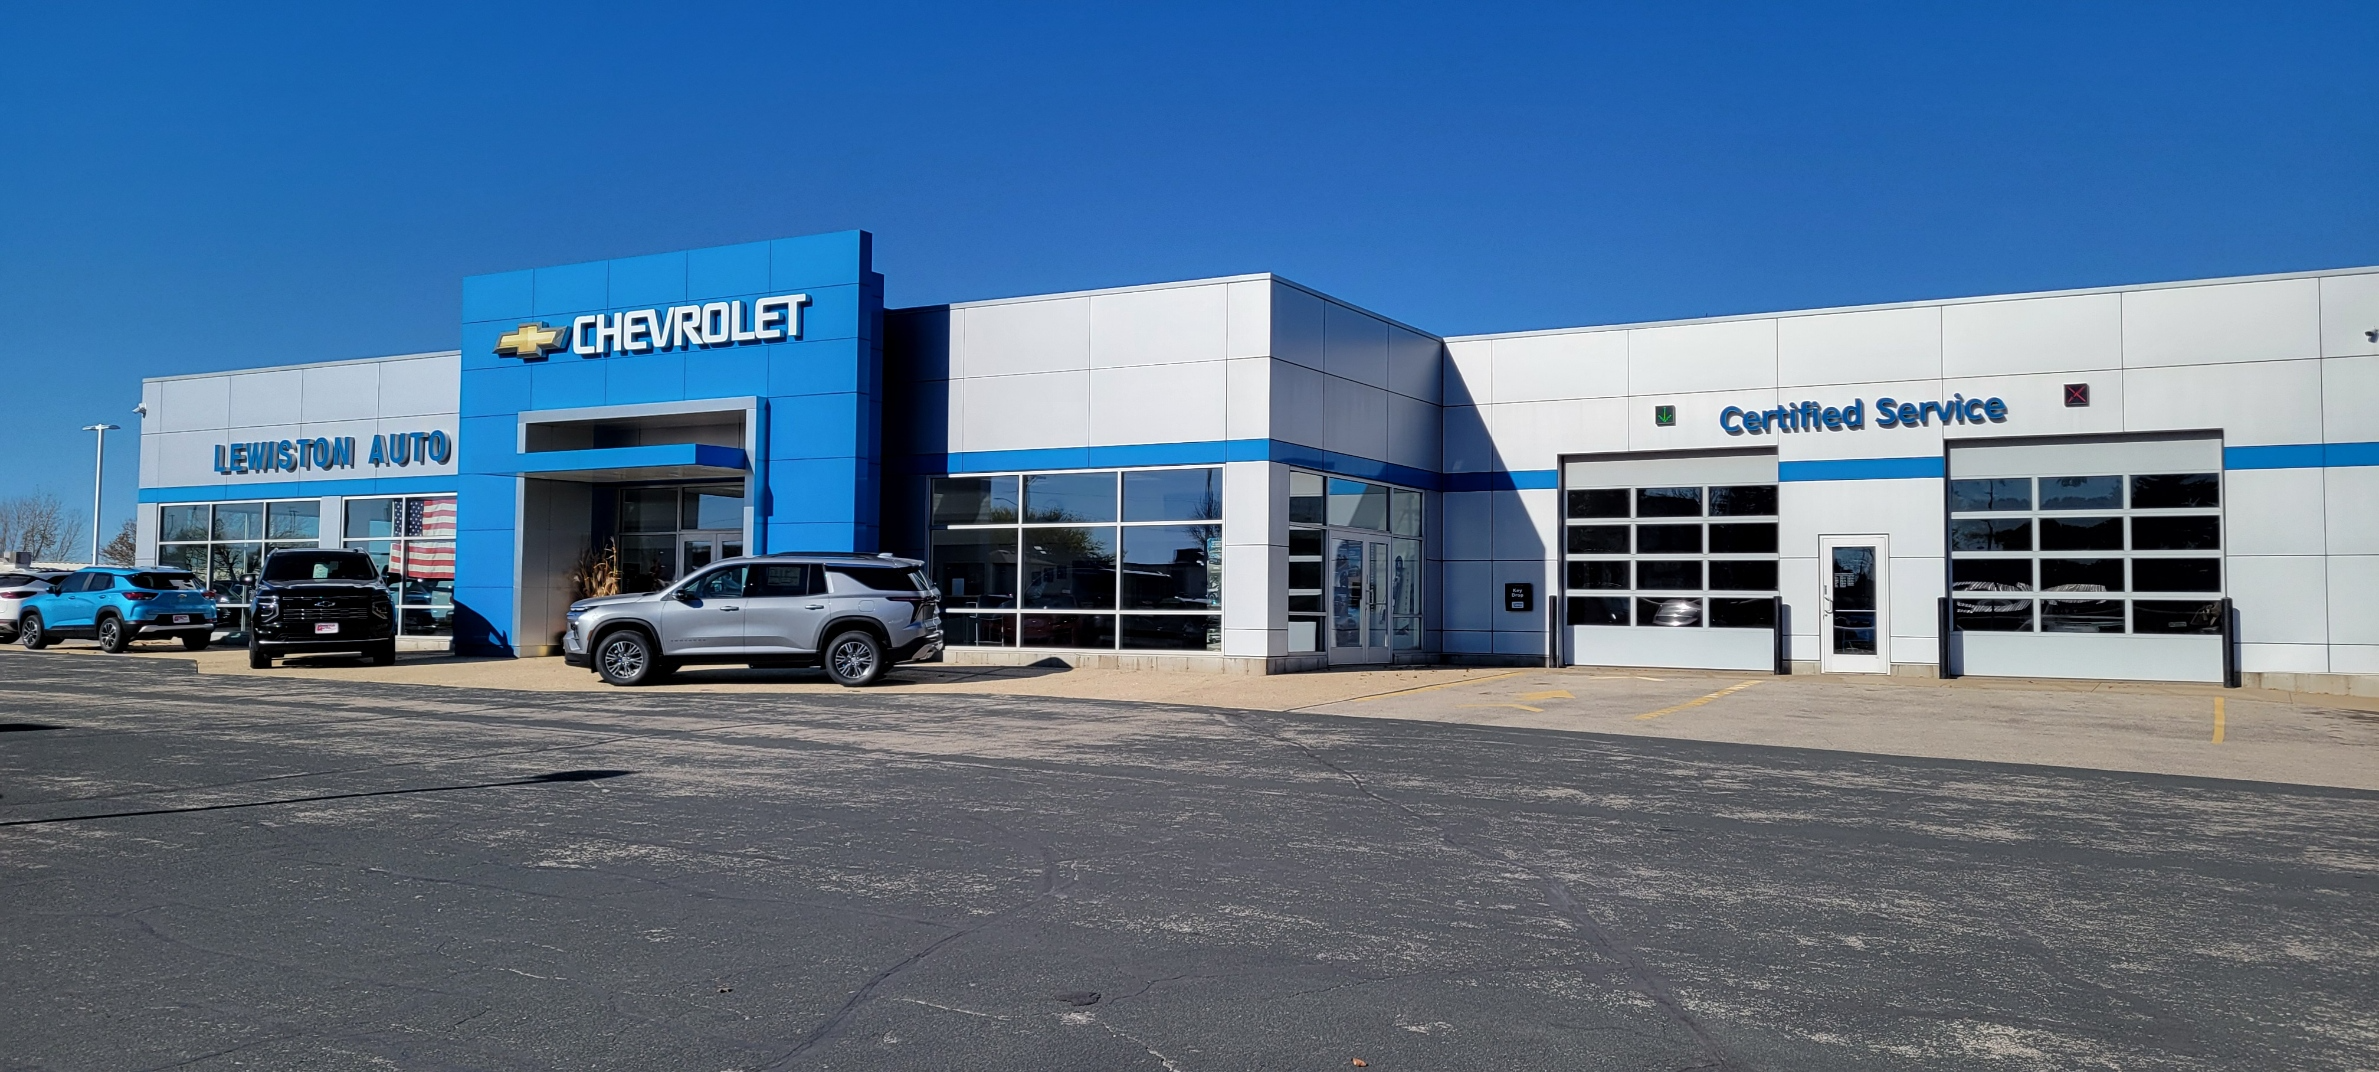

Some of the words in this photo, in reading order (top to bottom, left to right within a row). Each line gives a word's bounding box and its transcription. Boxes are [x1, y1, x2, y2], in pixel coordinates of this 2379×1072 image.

[573, 293, 808, 356] CHEVROLET
[1720, 398, 1864, 433] Certified
[1875, 393, 2007, 427] Service
[214, 436, 354, 474] LEWISTON
[368, 430, 449, 466] AUTO
